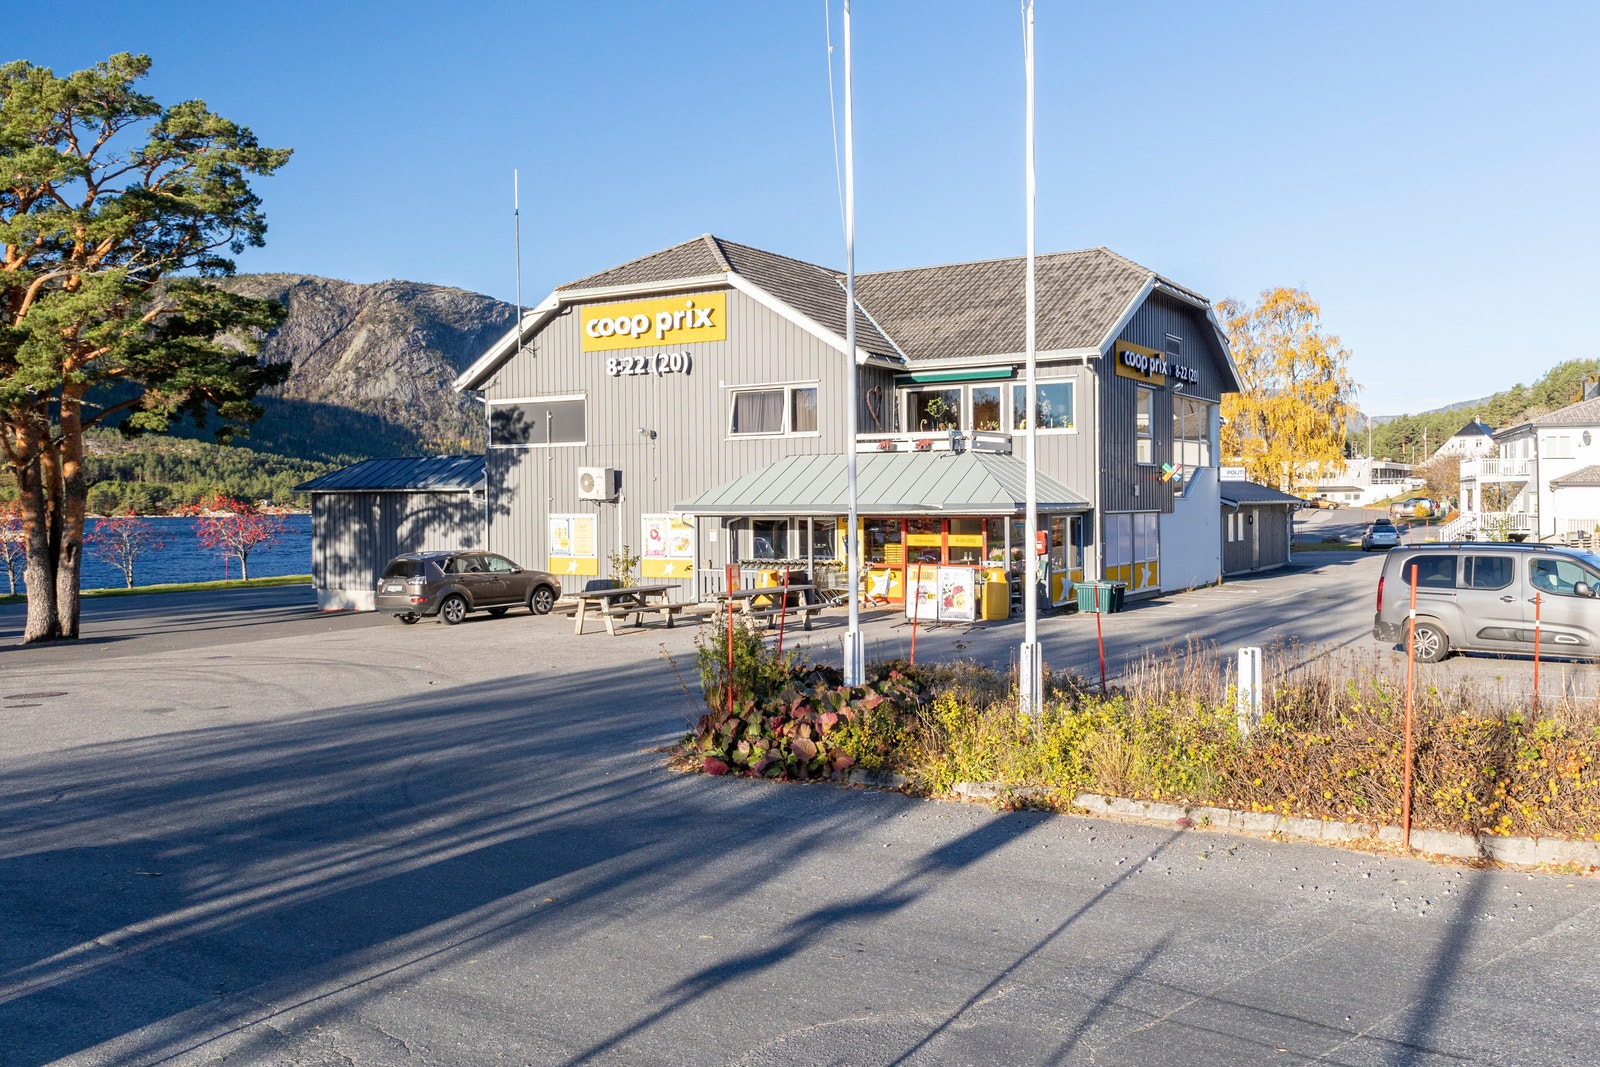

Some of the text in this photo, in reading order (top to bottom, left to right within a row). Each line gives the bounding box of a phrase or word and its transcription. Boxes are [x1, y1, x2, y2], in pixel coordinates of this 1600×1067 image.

[586, 300, 716, 339] coop prix
[606, 351, 690, 376] 8-22 (20)
[1124, 350, 1168, 378] coop prix
[1175, 364, 1188, 380] 8-22
